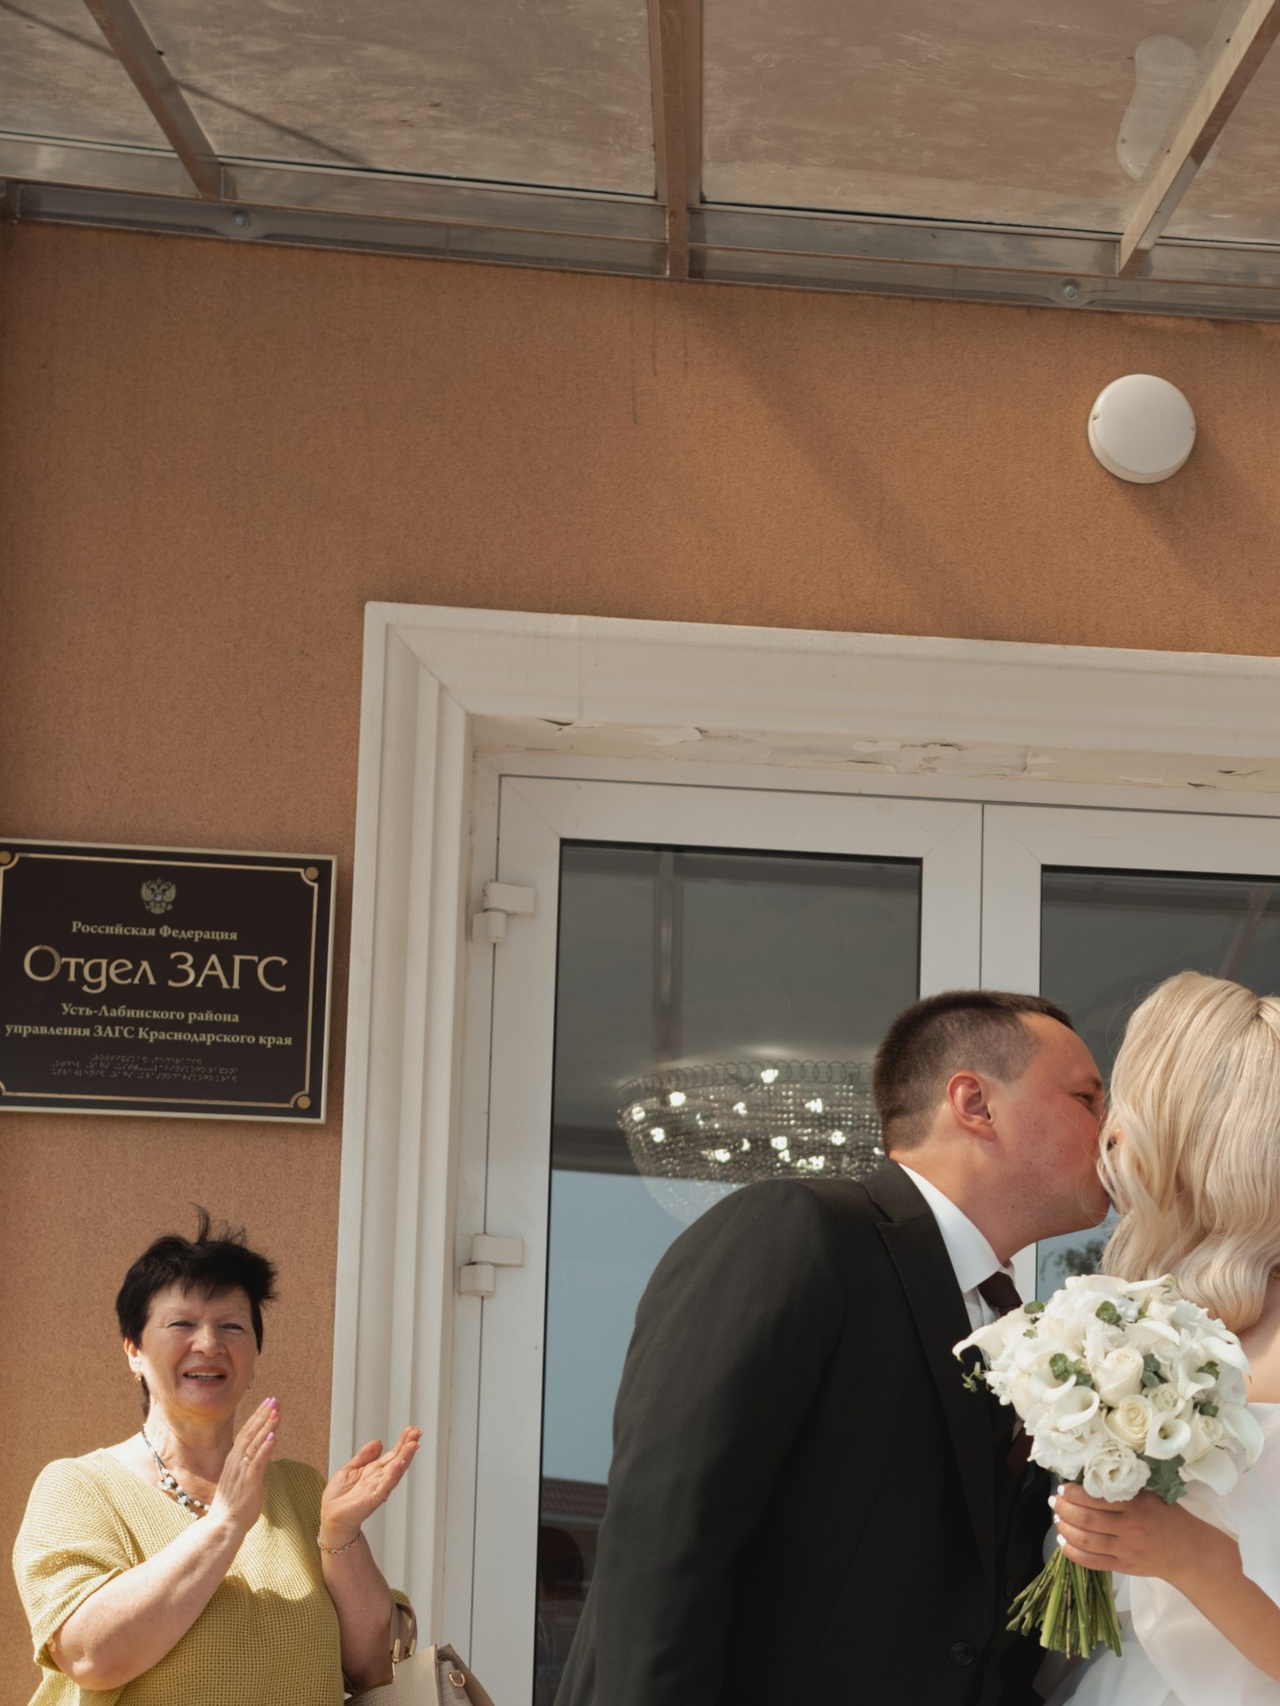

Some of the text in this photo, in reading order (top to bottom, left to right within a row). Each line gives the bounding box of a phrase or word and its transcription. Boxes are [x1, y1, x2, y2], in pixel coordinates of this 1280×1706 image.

[71, 920, 238, 942] Российская Федерация
[23, 944, 289, 995] Отдел ЗАГС
[61, 1002, 240, 1025] Усть-Лабинского района
[4, 1023, 293, 1049] управления ЗАГС Краснодарского края
